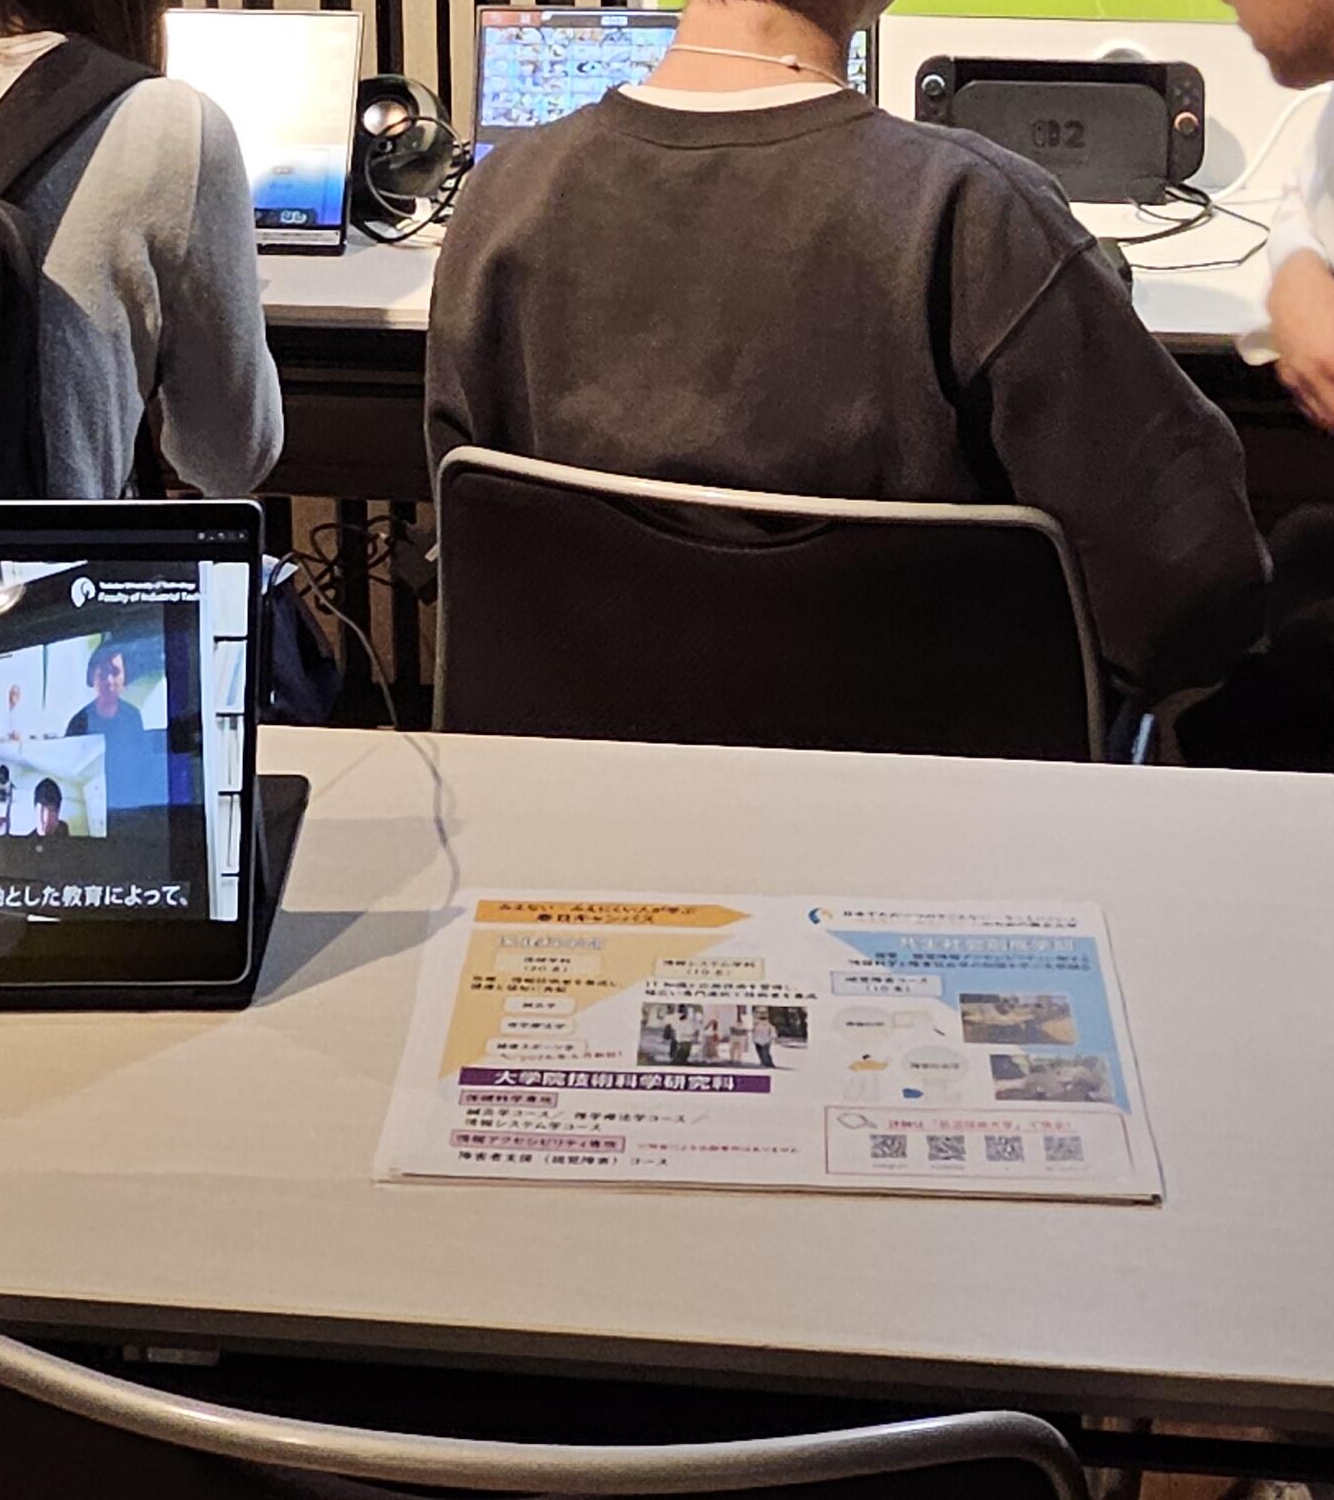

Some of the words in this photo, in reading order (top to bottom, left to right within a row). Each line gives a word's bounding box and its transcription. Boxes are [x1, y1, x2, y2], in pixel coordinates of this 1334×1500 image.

[493, 1070, 736, 1092] 大学院技術科学研究科
